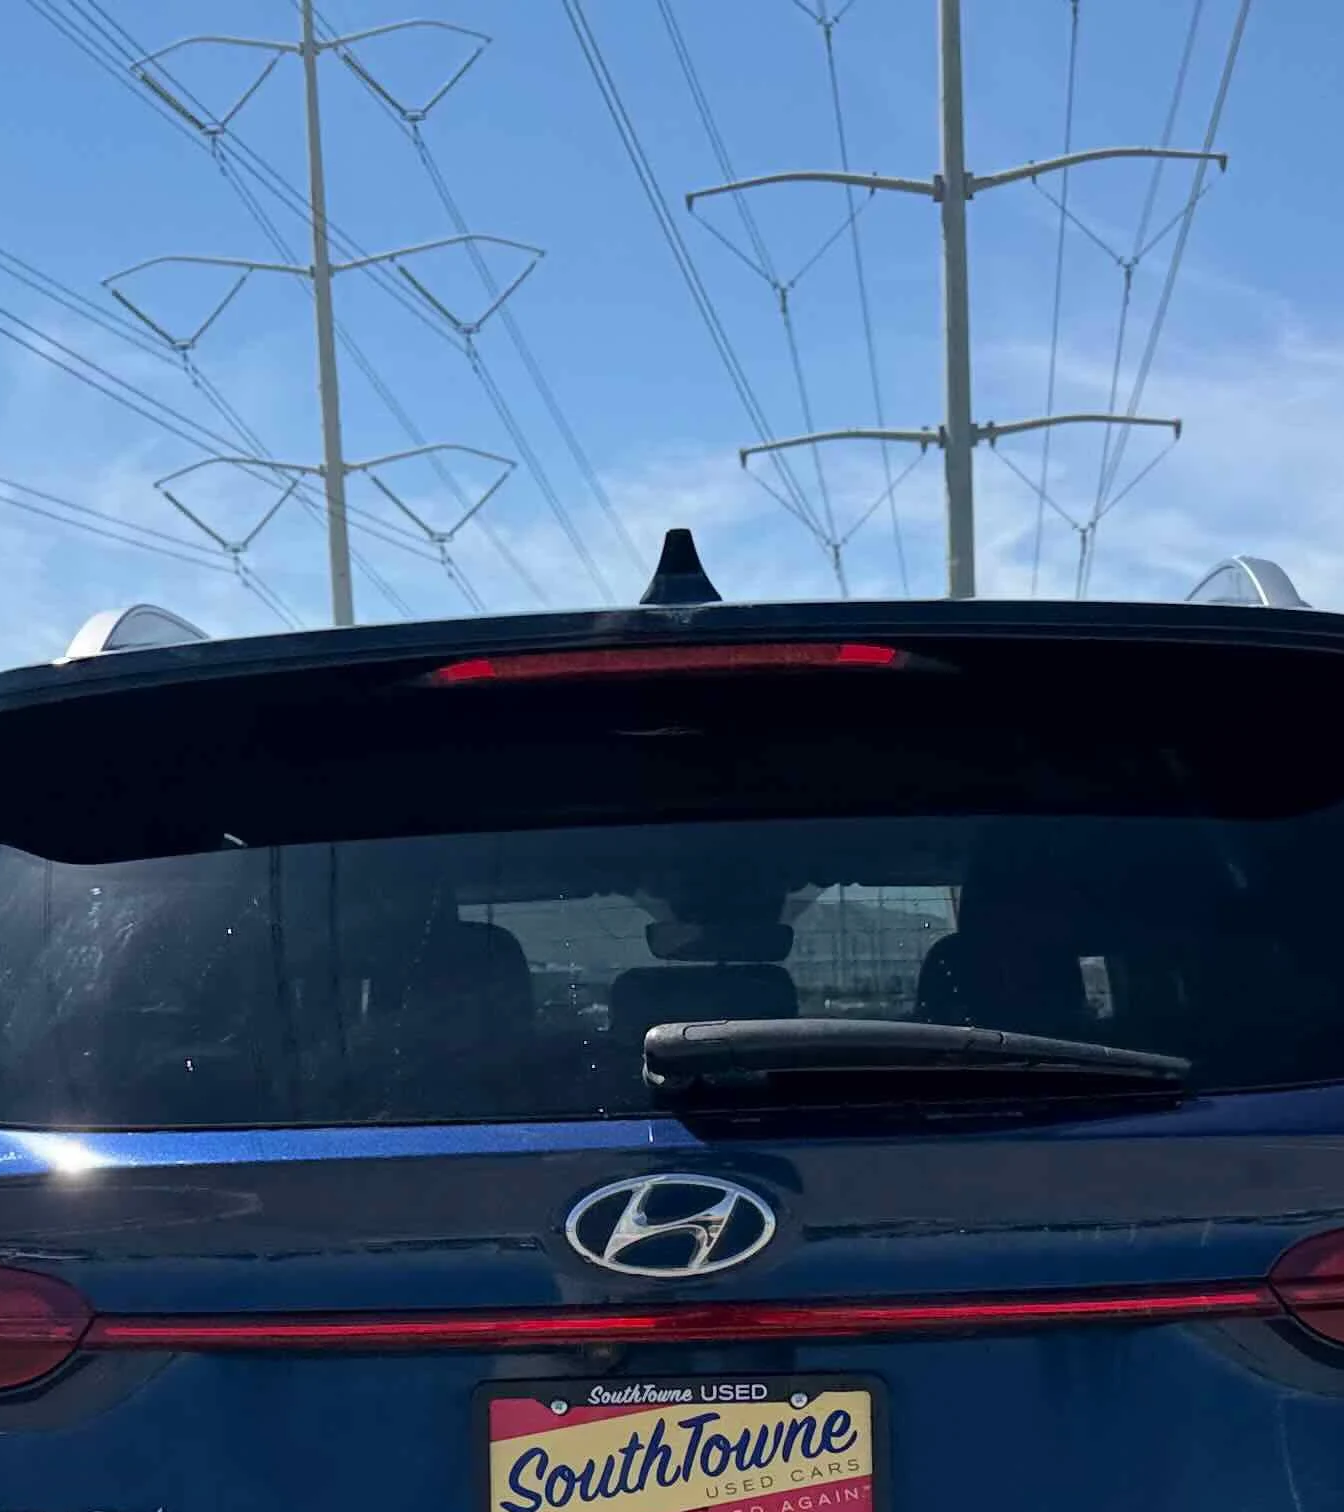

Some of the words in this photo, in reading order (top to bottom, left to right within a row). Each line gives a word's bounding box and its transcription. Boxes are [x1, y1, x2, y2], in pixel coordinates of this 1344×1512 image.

[587, 1384, 693, 1405] SouthTowne
[701, 1384, 768, 1401] USED
[705, 1475, 774, 1500] USED
[790, 1459, 861, 1484] CARS
